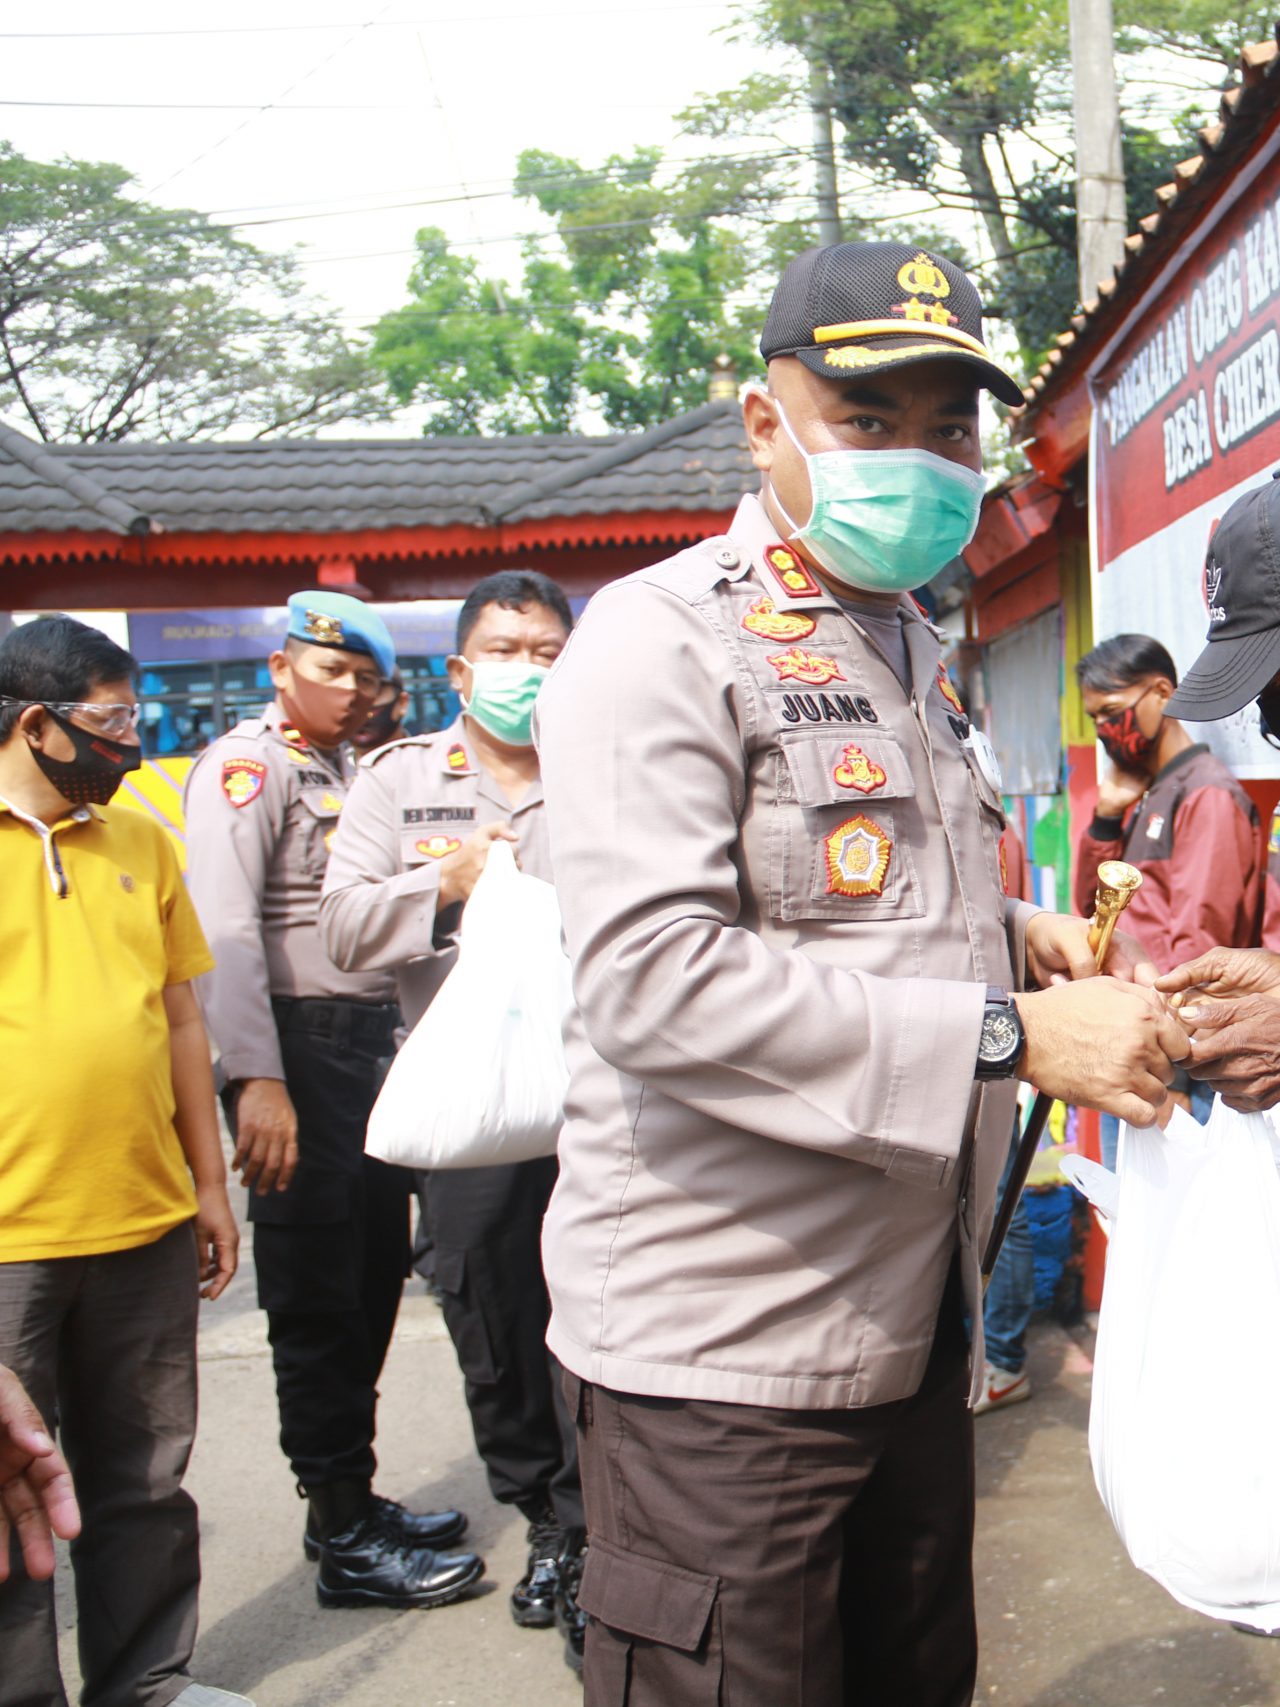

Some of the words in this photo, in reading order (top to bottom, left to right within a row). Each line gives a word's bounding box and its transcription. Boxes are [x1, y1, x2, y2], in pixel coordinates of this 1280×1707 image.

[1190, 248, 1243, 363] OJEG
[1163, 388, 1213, 489] DESA
[781, 692, 879, 724] JUANG
